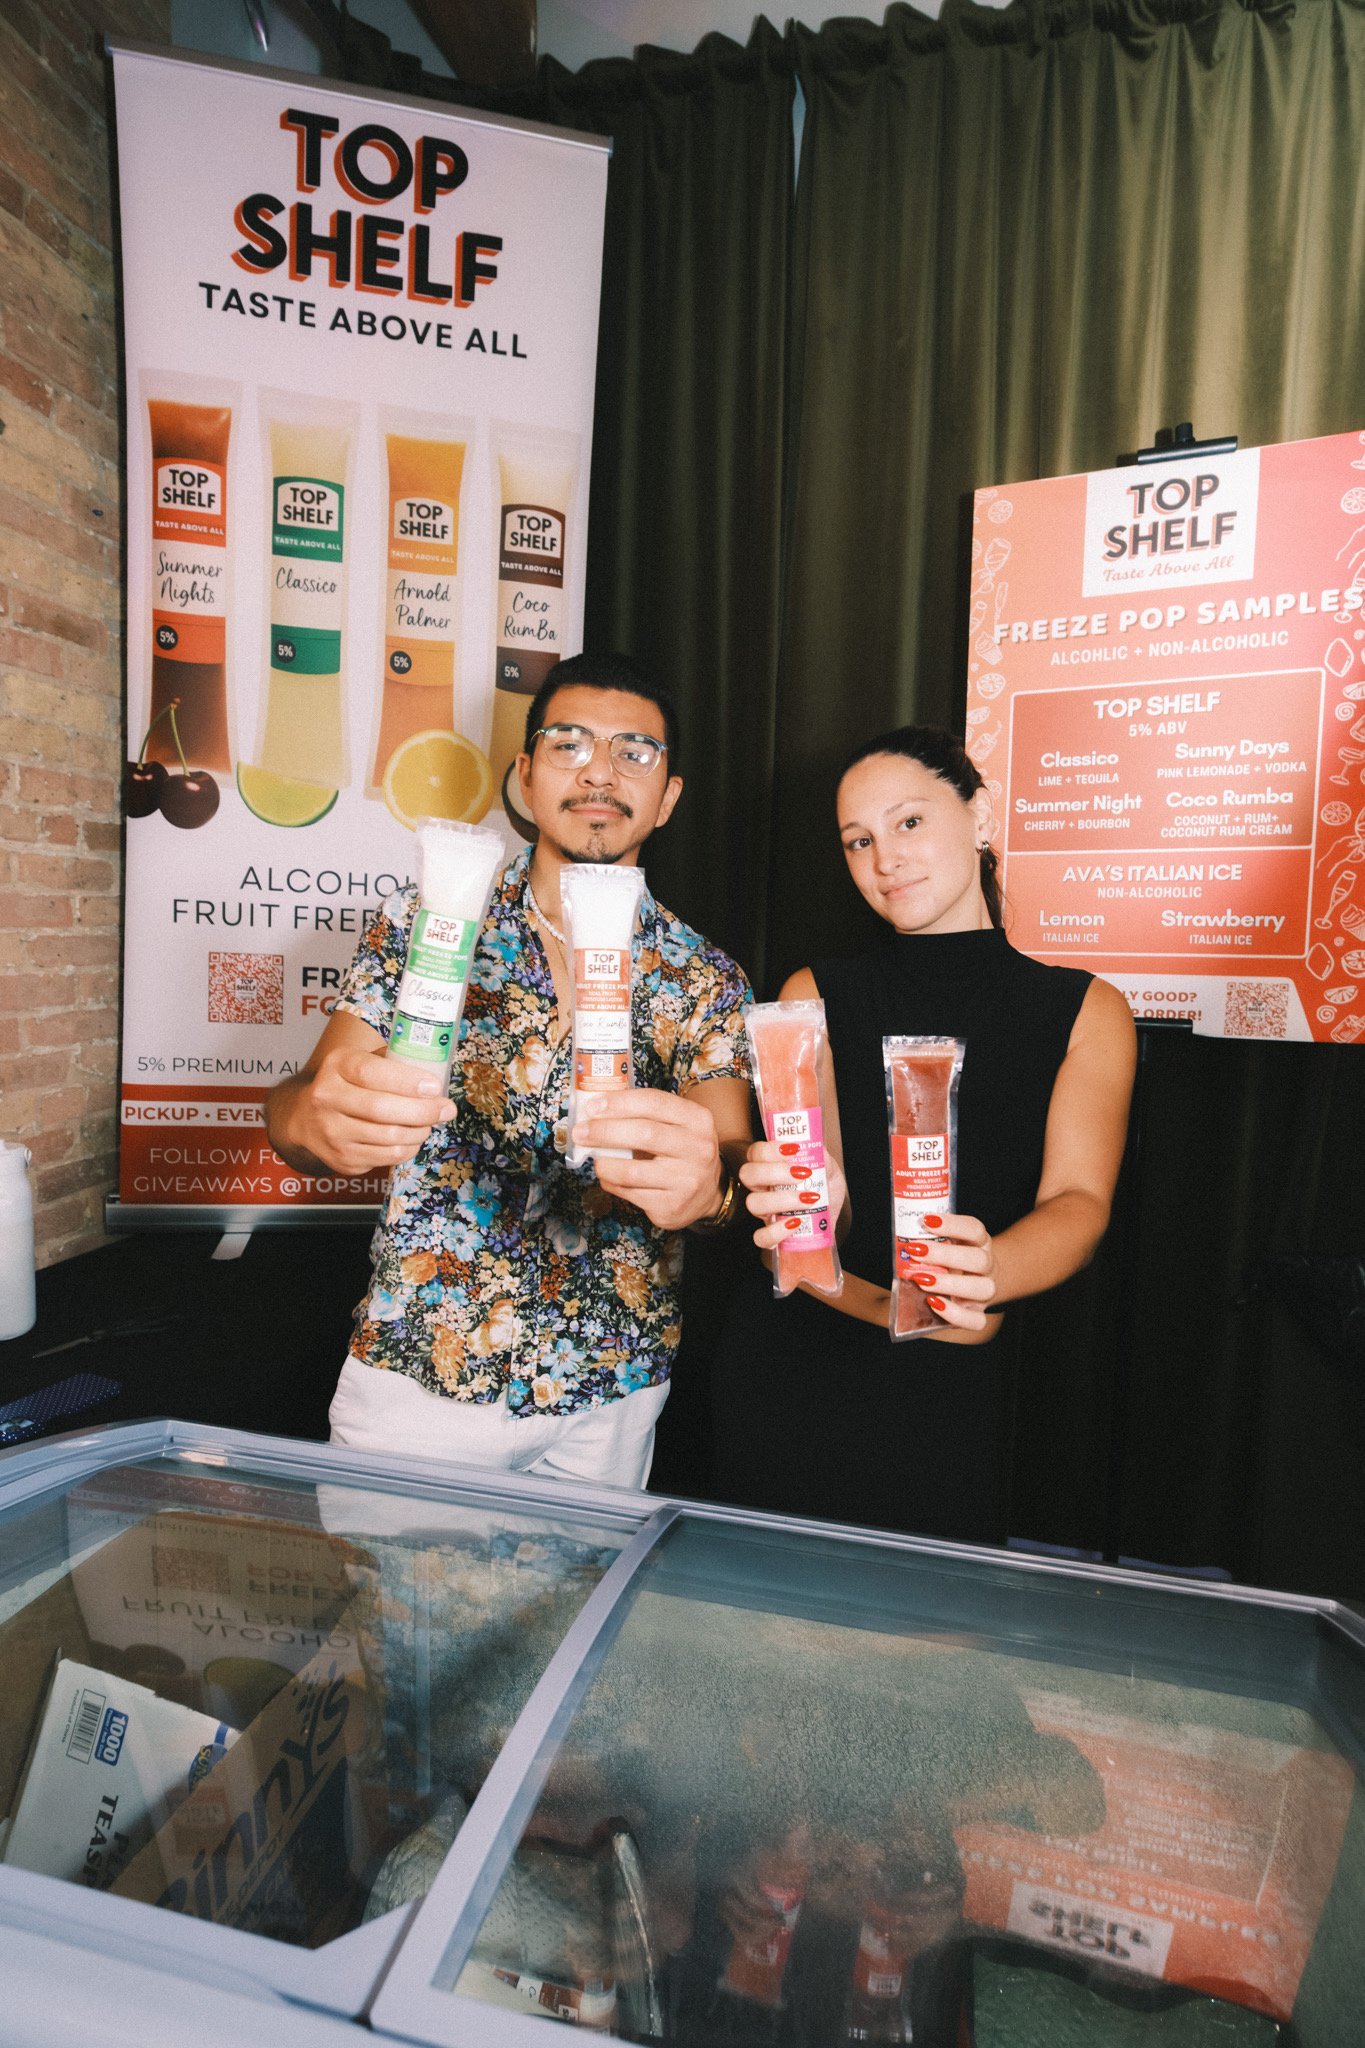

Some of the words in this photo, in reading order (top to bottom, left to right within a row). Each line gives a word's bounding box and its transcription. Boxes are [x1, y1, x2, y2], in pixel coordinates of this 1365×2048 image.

[280, 107, 469, 215] TOP
[231, 193, 503, 308] SHELF
[198, 281, 316, 327] TASTE
[329, 307, 453, 349] ABOVE
[464, 328, 528, 359] ALL
[169, 469, 208, 488] TOP
[162, 487, 216, 509] SHELF
[290, 487, 327, 505] TOP
[1126, 474, 1220, 518] TOP
[282, 505, 333, 525] SHELF
[406, 502, 443, 520] TOP
[155, 520, 179, 530] TASTE
[180, 523, 208, 533] ABOVE
[209, 526, 224, 536] ALL
[399, 520, 449, 539] SHELF
[517, 514, 552, 533] TOP
[275, 536, 298, 546] TASTE
[300, 539, 326, 549] ABOVE
[327, 542, 341, 550] ALL
[510, 532, 557, 552] SHELF
[1102, 511, 1238, 562] SHELF
[156, 551, 223, 578] Summer
[392, 550, 414, 560] TASTE
[415, 553, 440, 562] ABOVE
[501, 561, 522, 570] TASTE
[524, 564, 548, 574] ABOVE
[549, 567, 561, 576] ALL
[1103, 566, 1144, 583] Taste
[1149, 560, 1201, 577] Above
[1202, 555, 1233, 569] All
[275, 566, 337, 593] Classico
[160, 577, 215, 607] Nights
[393, 578, 450, 602] Arnold
[512, 591, 550, 614] Coco
[395, 604, 451, 629] Palmer
[993, 613, 1109, 645] FREEZE
[1119, 605, 1186, 633] POP
[1197, 587, 1364, 625] SAMPLES
[504, 615, 557, 641] RumBa
[159, 631, 175, 644] 5%
[278, 644, 294, 657] 5%
[1050, 645, 1128, 666] ALCOHLIC
[1148, 630, 1289, 658] NON-ALCOHOLIC
[393, 656, 409, 668] 5%
[504, 665, 519, 678] 5%
[1093, 698, 1142, 719] TOP
[1146, 691, 1221, 716] SHELF
[1128, 723, 1152, 737] 5%
[1157, 721, 1188, 735] ABV
[1175, 742, 1235, 761] Sunny
[1239, 739, 1290, 759] Days
[1040, 751, 1119, 768] Classico
[1157, 767, 1184, 779] PINK
[1186, 764, 1250, 777] LEMONADE
[1264, 761, 1307, 773] VODKA
[1038, 775, 1062, 786] LIME
[1075, 773, 1120, 785] TEQUILA
[1015, 798, 1090, 814] Summer
[1093, 793, 1143, 815] Night
[1165, 791, 1217, 808] Coco
[1222, 786, 1293, 805] Rumba
[1024, 819, 1065, 831] CHERRY
[1078, 818, 1131, 830] BOURBON
[1174, 814, 1230, 826] COCONUT
[1160, 826, 1217, 838] COCONUT
[1219, 825, 1245, 836] RUM
[1249, 824, 1293, 836] CREAM
[1062, 865, 1123, 882] AVA'S
[1127, 865, 1203, 881] ITALIAN
[1208, 864, 1242, 881] ICE
[1097, 887, 1203, 898] NON-ALCOHOLIC
[172, 899, 280, 928] FRUIT
[1039, 910, 1105, 926] Lemon
[1161, 908, 1285, 933] Strawberry
[433, 919, 457, 931] TOP
[426, 928, 460, 944] SHELF
[1043, 933, 1081, 943] ITALIAN
[1083, 933, 1100, 943] ICE
[1189, 934, 1232, 944] ITALIAN
[1234, 934, 1253, 945] ICE
[593, 953, 615, 963] TOP
[302, 966, 348, 989] FR
[587, 964, 619, 974] SHELF
[406, 978, 454, 1002] Classico
[1142, 991, 1198, 1003] GOOD?
[1143, 1009, 1202, 1020] ORDER!
[137, 1056, 166, 1072] 5%
[172, 1057, 273, 1075] PREMIUM
[124, 1106, 199, 1121] PICKUP
[781, 1116, 802, 1125] TOP
[777, 1125, 808, 1136] SHELF
[916, 1141, 939, 1150] TOP
[150, 1148, 251, 1165] FOLLOW
[911, 1151, 942, 1161] SHELF
[133, 1176, 273, 1193] GIVEAWAYS
[102, 1715, 127, 1763] 1000
